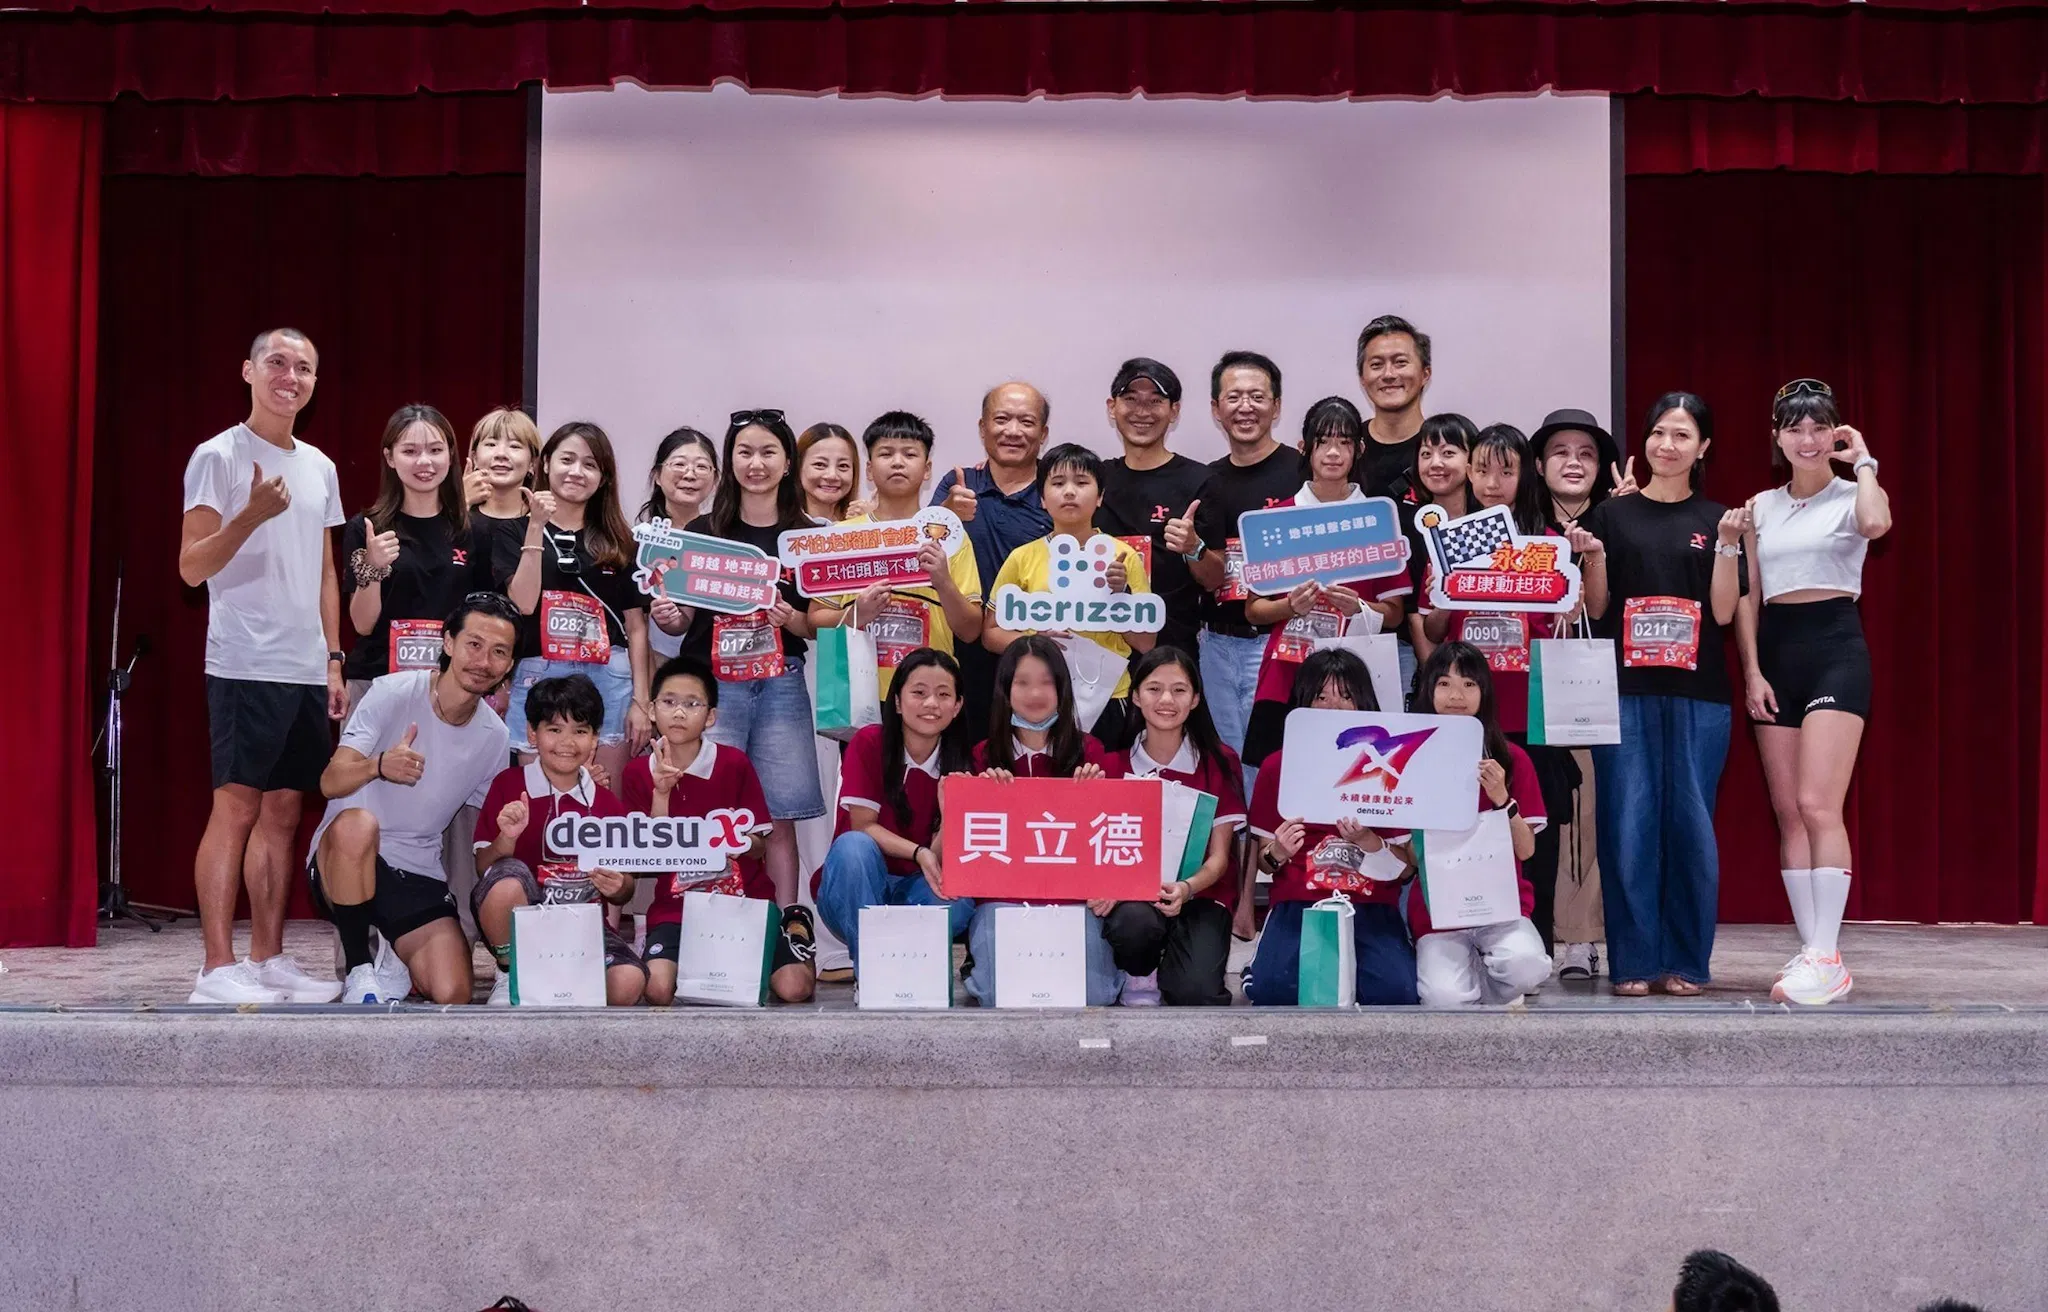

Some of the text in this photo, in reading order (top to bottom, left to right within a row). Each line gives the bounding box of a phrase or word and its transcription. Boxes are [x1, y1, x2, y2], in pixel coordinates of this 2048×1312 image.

[1289, 515, 1377, 540] 地平線整合運動
[636, 531, 681, 548] horizon
[690, 554, 769, 577] 跨越 地平線
[1490, 541, 1558, 573] 永續
[826, 557, 921, 582] 只怕頭腦不轉
[694, 578, 765, 601] 讓愛動起來
[1456, 575, 1554, 595] 健康動起來
[1005, 593, 1157, 623] horizon
[550, 616, 583, 632] 0282
[1465, 626, 1499, 640] 0090
[1634, 622, 1668, 636] 0211
[400, 646, 434, 660] 0271
[721, 638, 754, 652] 0173
[1340, 792, 1414, 805] 永續健康動起來
[1357, 807, 1385, 815] dentsu
[551, 817, 699, 848] dentsu
[959, 810, 1143, 866] 貝立德
[598, 858, 707, 866] EXPERIENCE BEYOND
